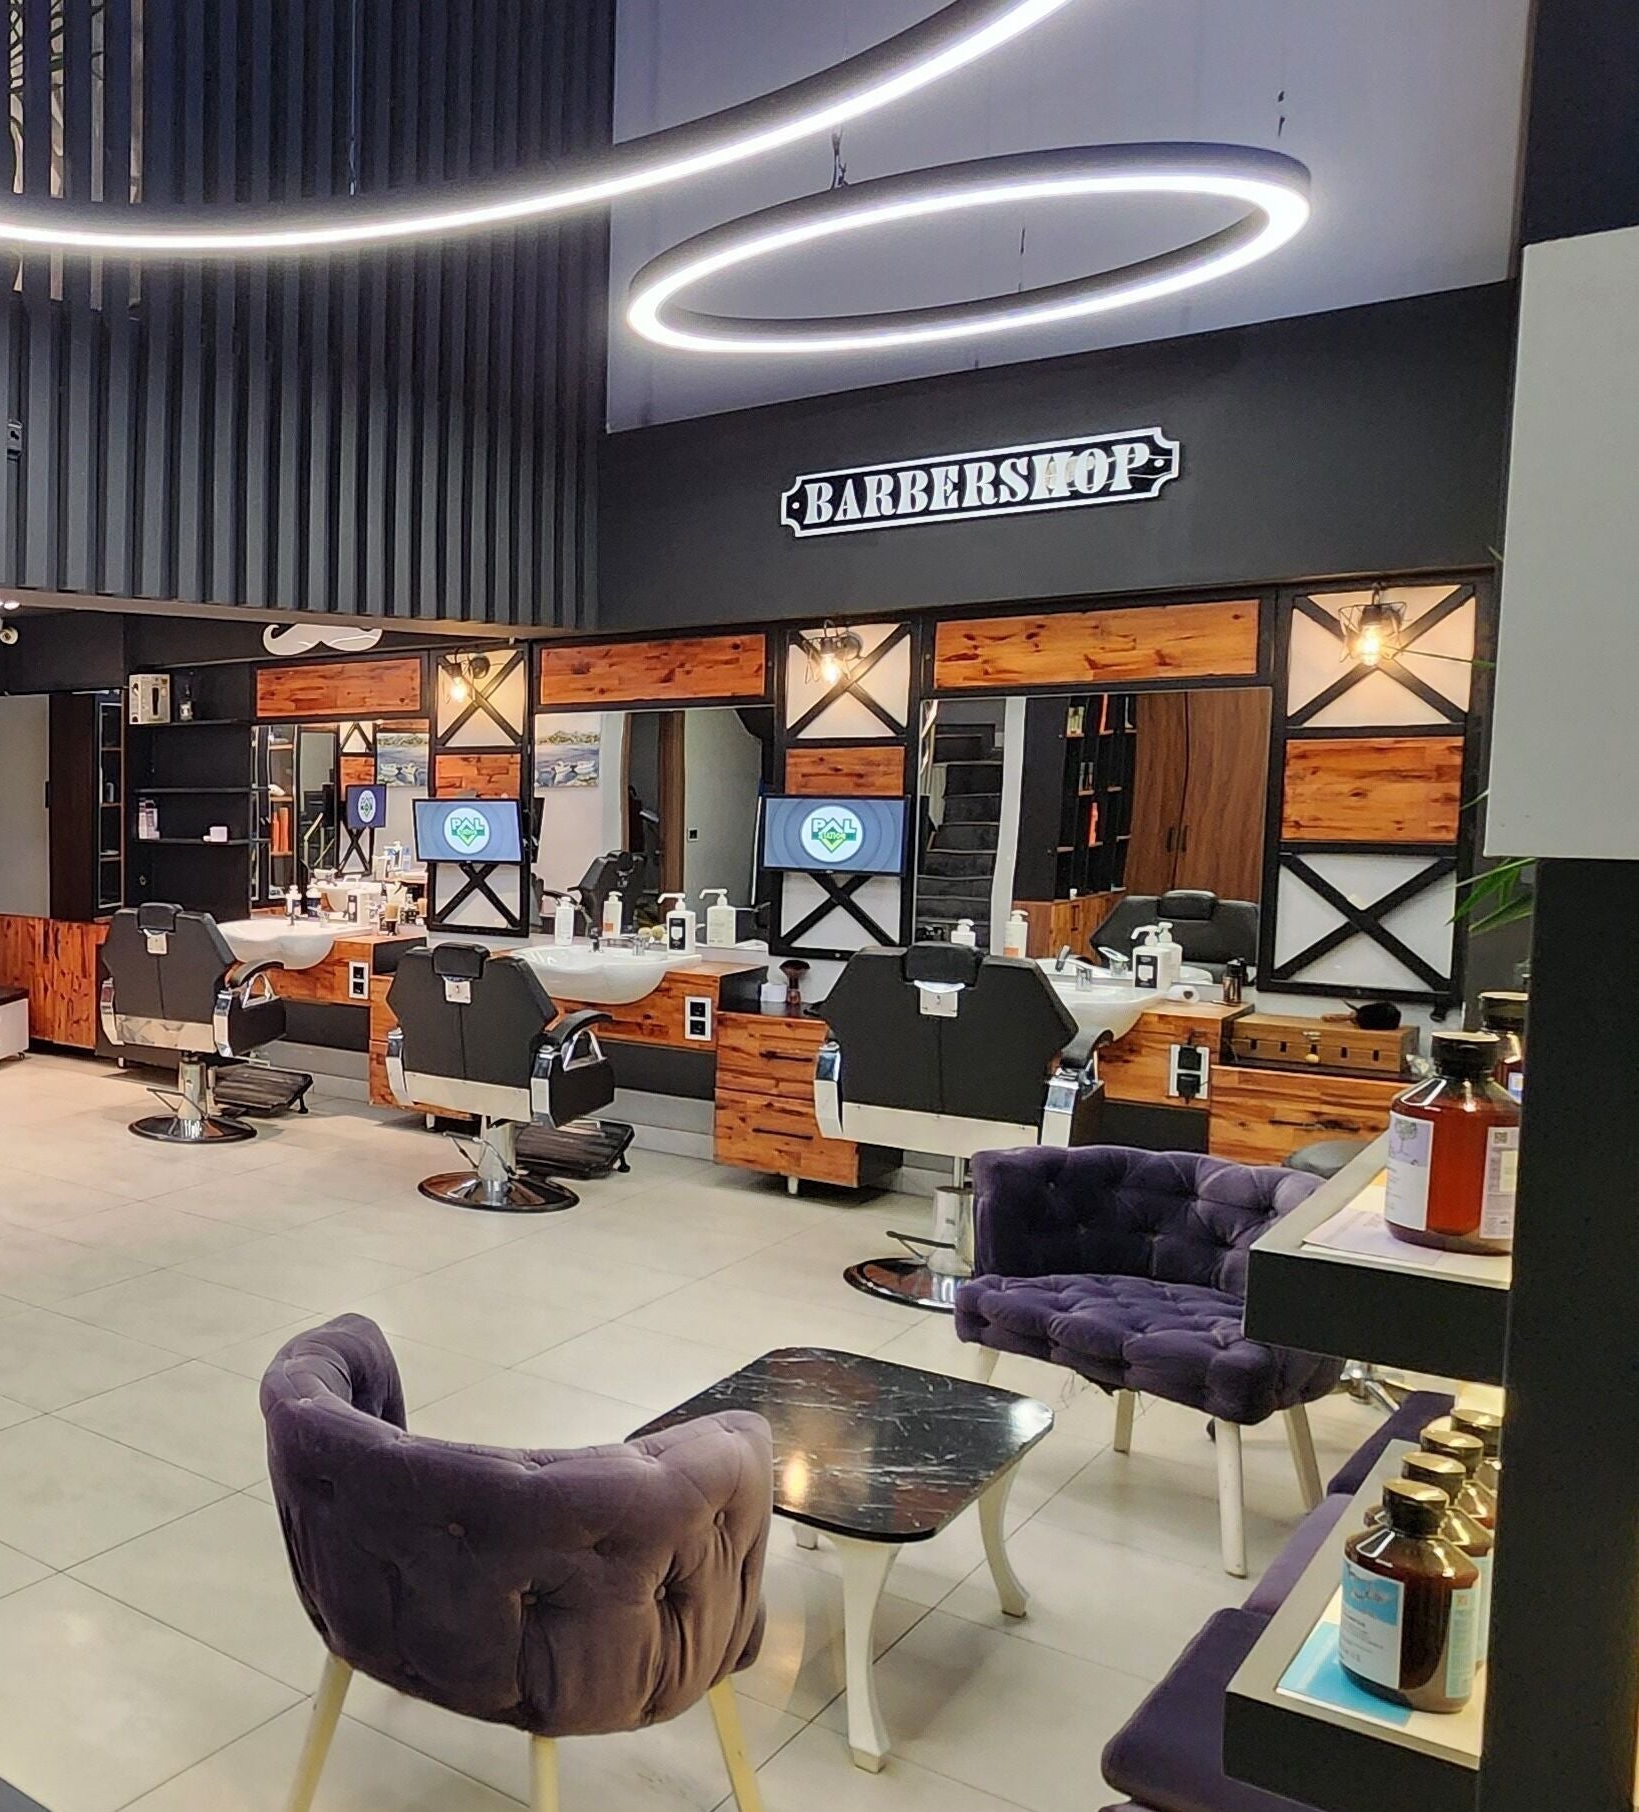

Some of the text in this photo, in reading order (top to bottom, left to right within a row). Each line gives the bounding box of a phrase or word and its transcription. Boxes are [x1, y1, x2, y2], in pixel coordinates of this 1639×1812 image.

[803, 442, 1151, 525] BARBERSHOP
[450, 817, 485, 831] PAL
[811, 817, 858, 834] PAL
